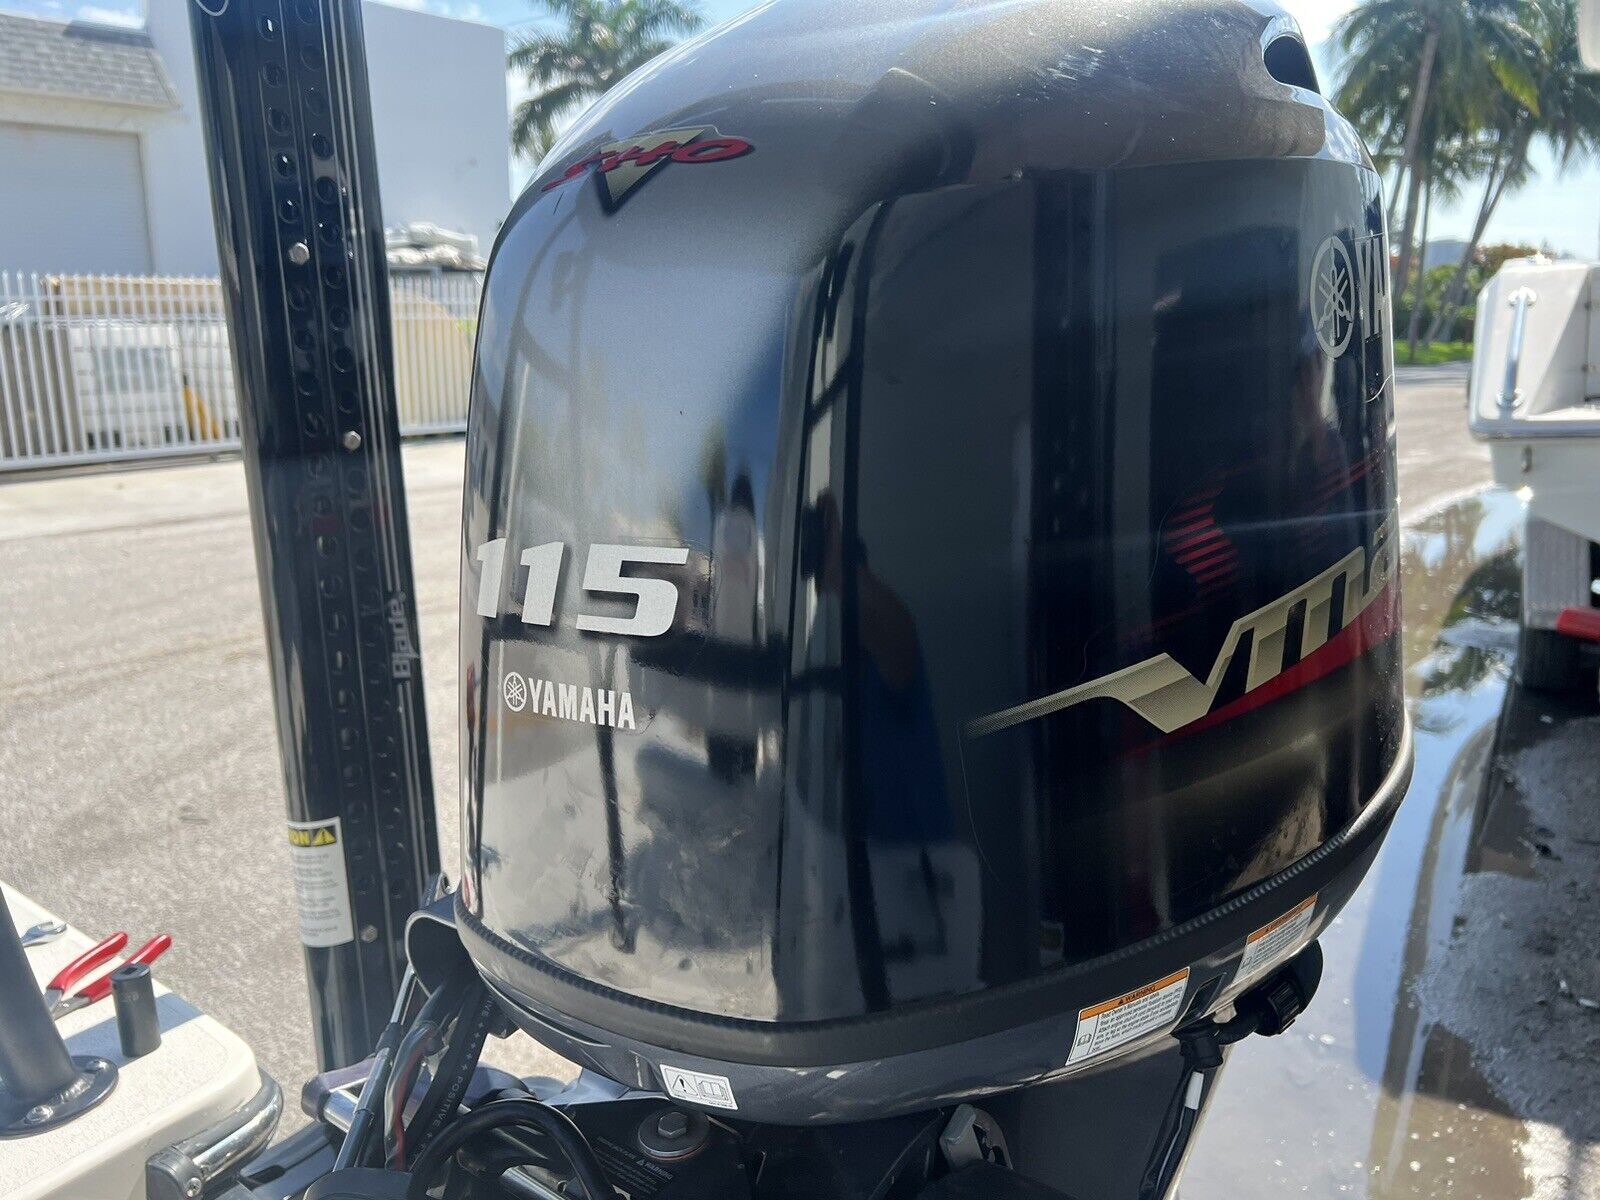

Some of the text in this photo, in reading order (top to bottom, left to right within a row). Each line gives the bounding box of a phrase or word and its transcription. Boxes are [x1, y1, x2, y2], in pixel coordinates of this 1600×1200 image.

[476, 538, 690, 637] 115
[528, 677, 636, 730] YAMAHA
[432, 1076, 465, 1128] POSITIVE
